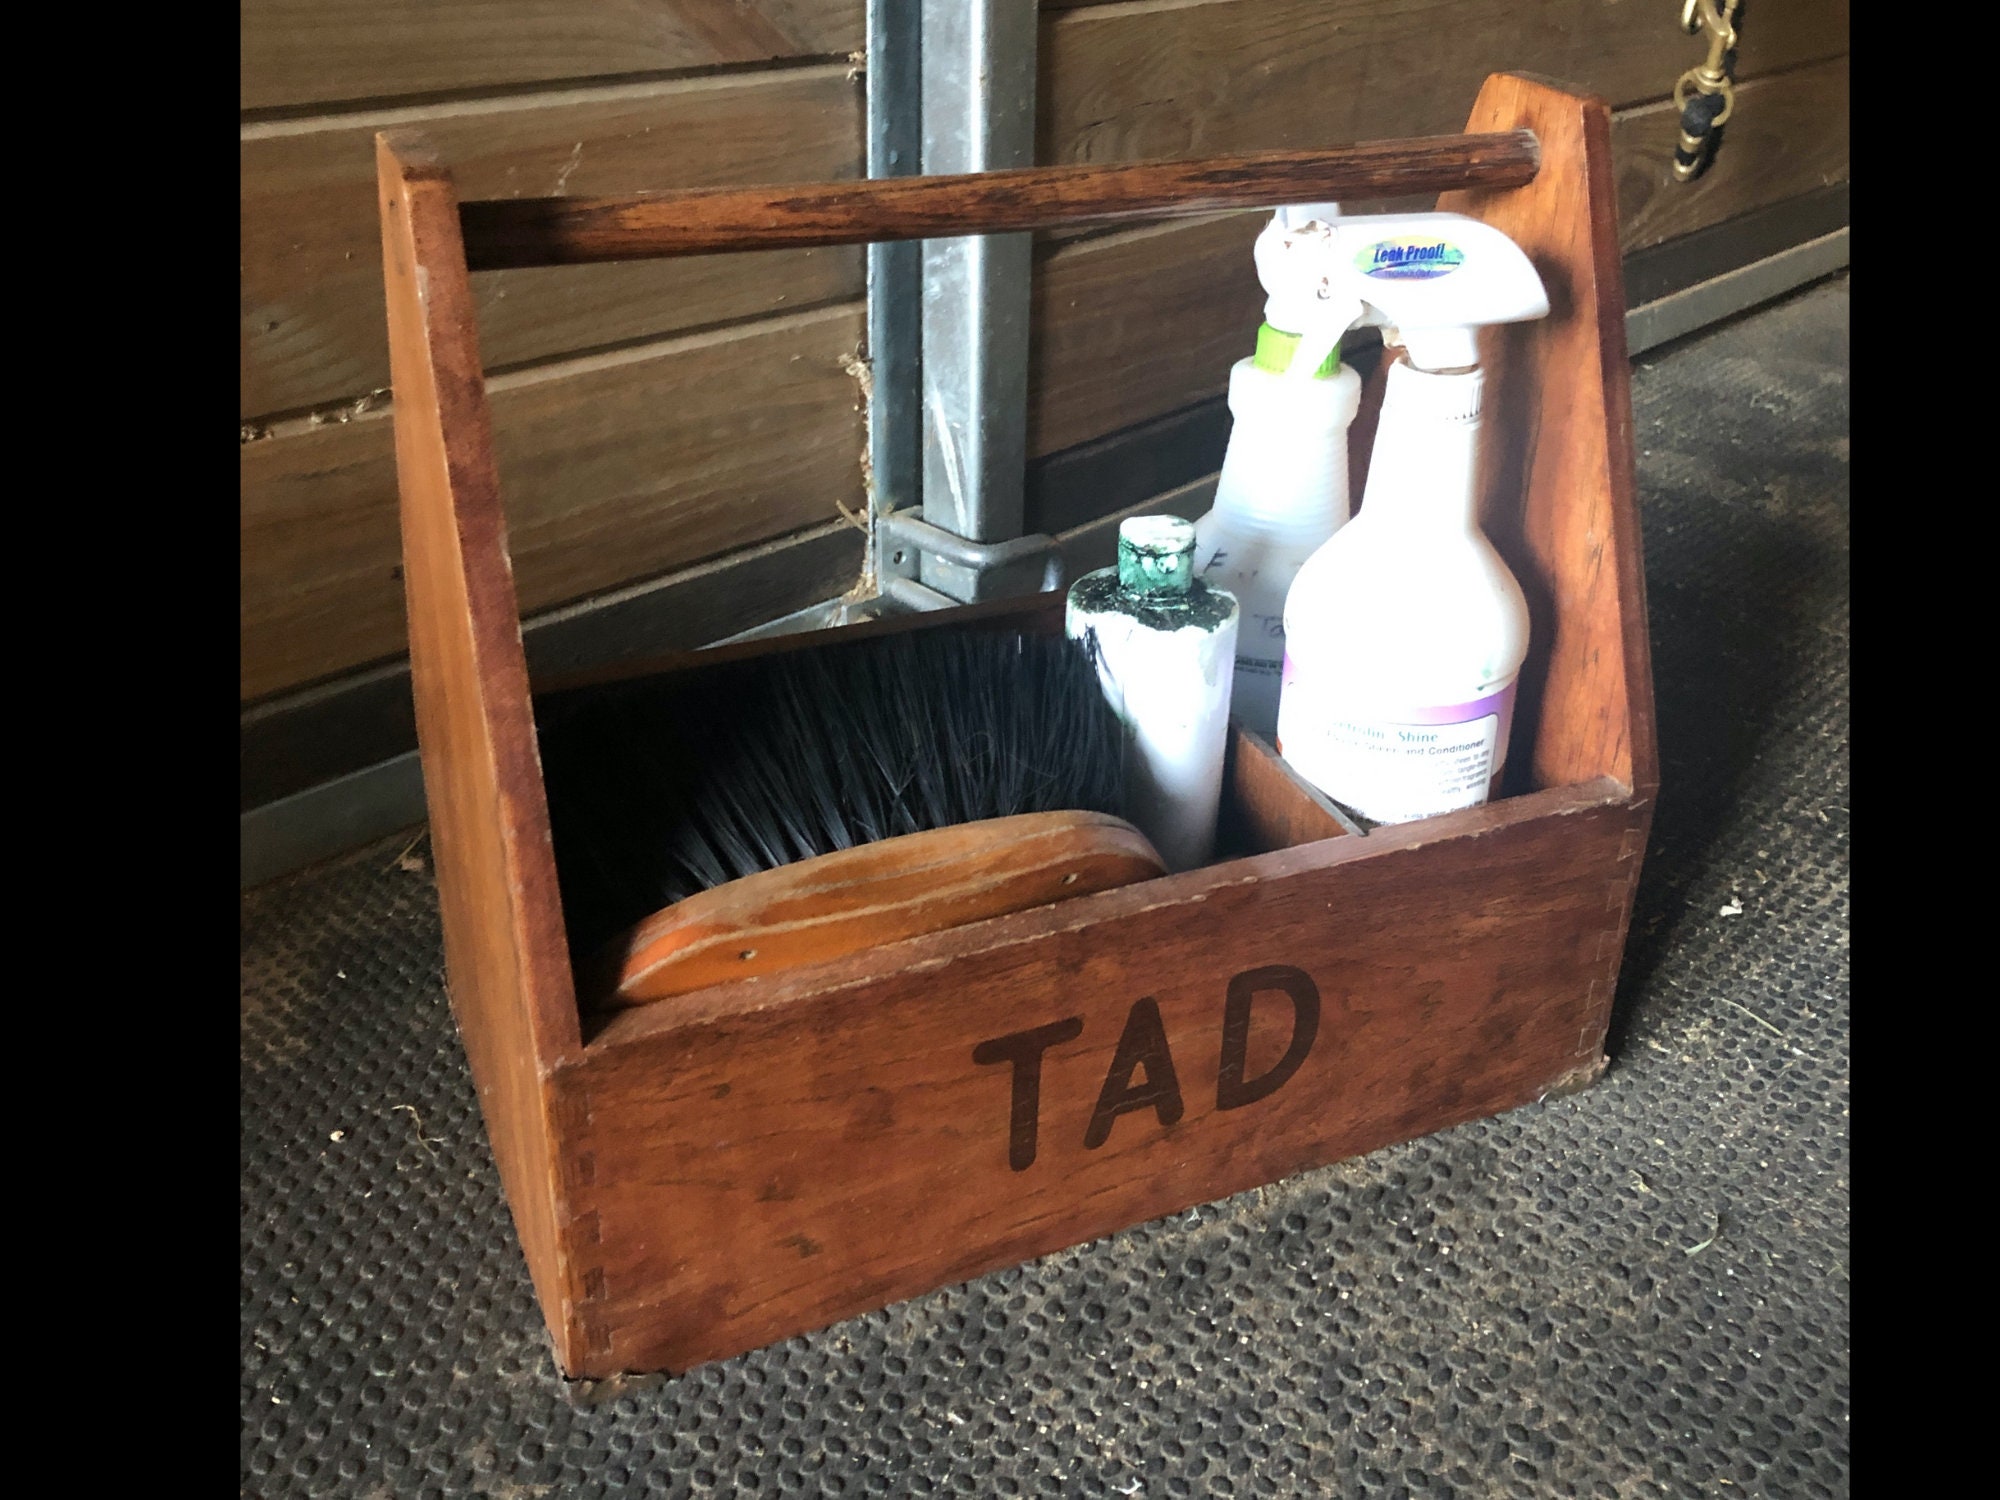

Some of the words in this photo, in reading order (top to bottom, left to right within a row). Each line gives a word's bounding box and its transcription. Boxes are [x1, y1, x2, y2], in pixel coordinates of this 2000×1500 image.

[1374, 246, 1404, 263] Leak
[1405, 243, 1445, 260] Proof!
[1398, 730, 1439, 743] Shine
[1428, 739, 1485, 756] Conditioner
[972, 964, 1321, 1172] TAD
